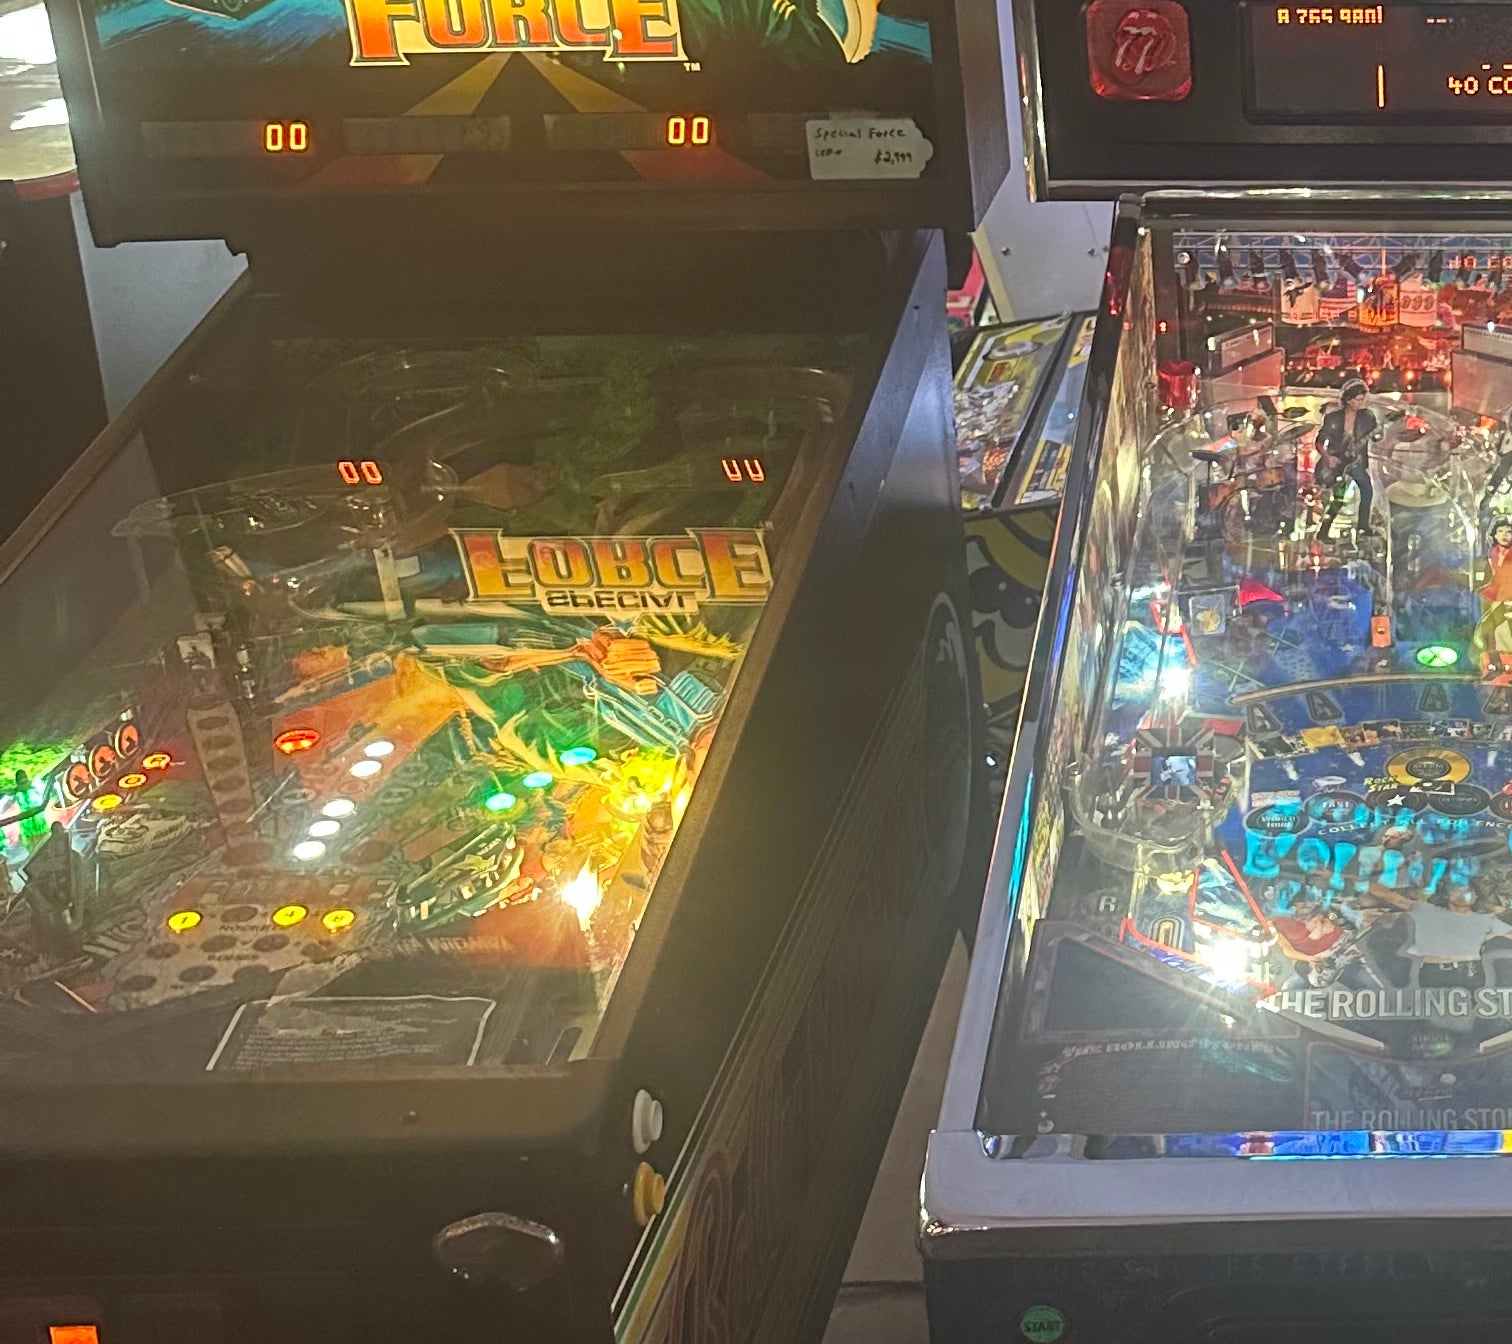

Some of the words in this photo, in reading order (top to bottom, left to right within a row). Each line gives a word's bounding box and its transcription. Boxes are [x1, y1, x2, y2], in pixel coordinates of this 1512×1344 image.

[683, 62, 701, 72] TM
[1448, 76, 1479, 95] 40
[264, 123, 309, 152] 00
[669, 117, 709, 144] 00
[815, 126, 862, 141] Special
[868, 127, 908, 139] Force
[1331, 988, 1469, 1019] ROLLING
